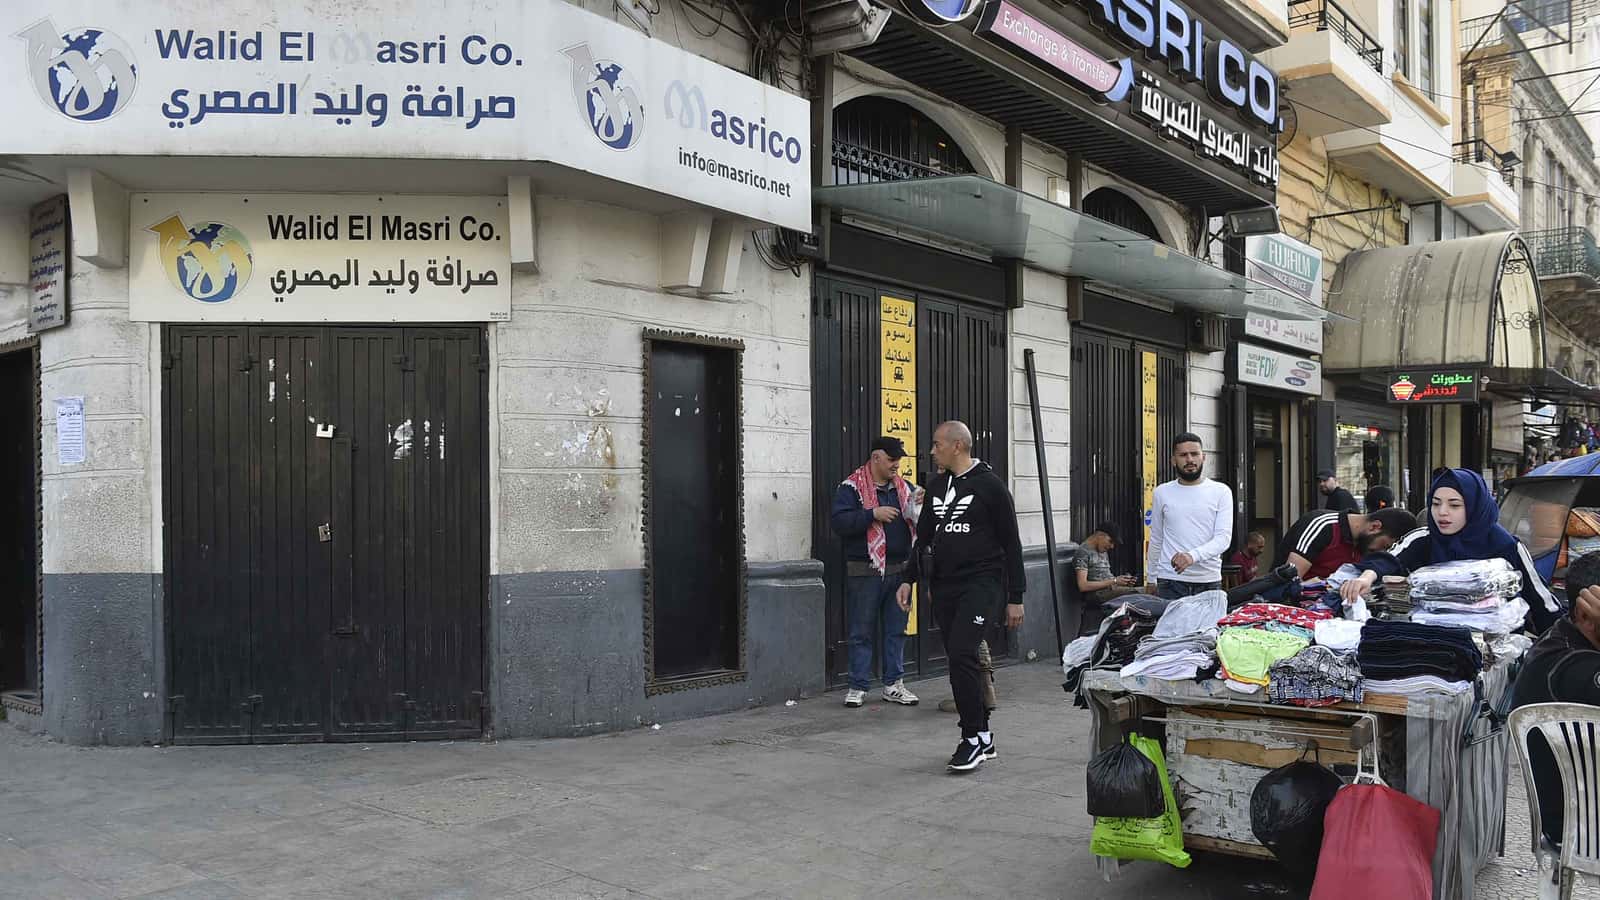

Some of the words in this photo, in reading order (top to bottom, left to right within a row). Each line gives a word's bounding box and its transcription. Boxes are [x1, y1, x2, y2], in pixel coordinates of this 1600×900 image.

[155, 29, 262, 61] Walid
[279, 31, 314, 62] El
[461, 35, 523, 66] Co.
[1003, 10, 1058, 56] Exchange
[1061, 44, 1070, 62] &
[1072, 50, 1109, 85] Transfer
[1096, 0, 1204, 81] SRI
[1218, 39, 1284, 132] CO.
[161, 83, 298, 129] المصري
[312, 84, 389, 128] وليد
[401, 84, 516, 130] صرافة
[1141, 70, 1201, 141] للصيرفة
[1202, 118, 1250, 168] المصري
[678, 146, 791, 198] info@masrico.net
[1253, 145, 1279, 186] وليد
[268, 214, 339, 241] Walid
[348, 215, 372, 241] El
[381, 215, 450, 241] Masri
[459, 215, 501, 242] Co.
[368, 259, 419, 294] وليد
[426, 255, 498, 294] صرافة
[1268, 240, 1312, 279] FUJIFILM
[270, 258, 359, 302] المصري
[885, 330, 911, 343] رسوم
[1431, 373, 1473, 386] عطورات
[884, 392, 912, 412] ضريبة
[886, 417, 912, 434] الدخل
[935, 521, 971, 533] das
